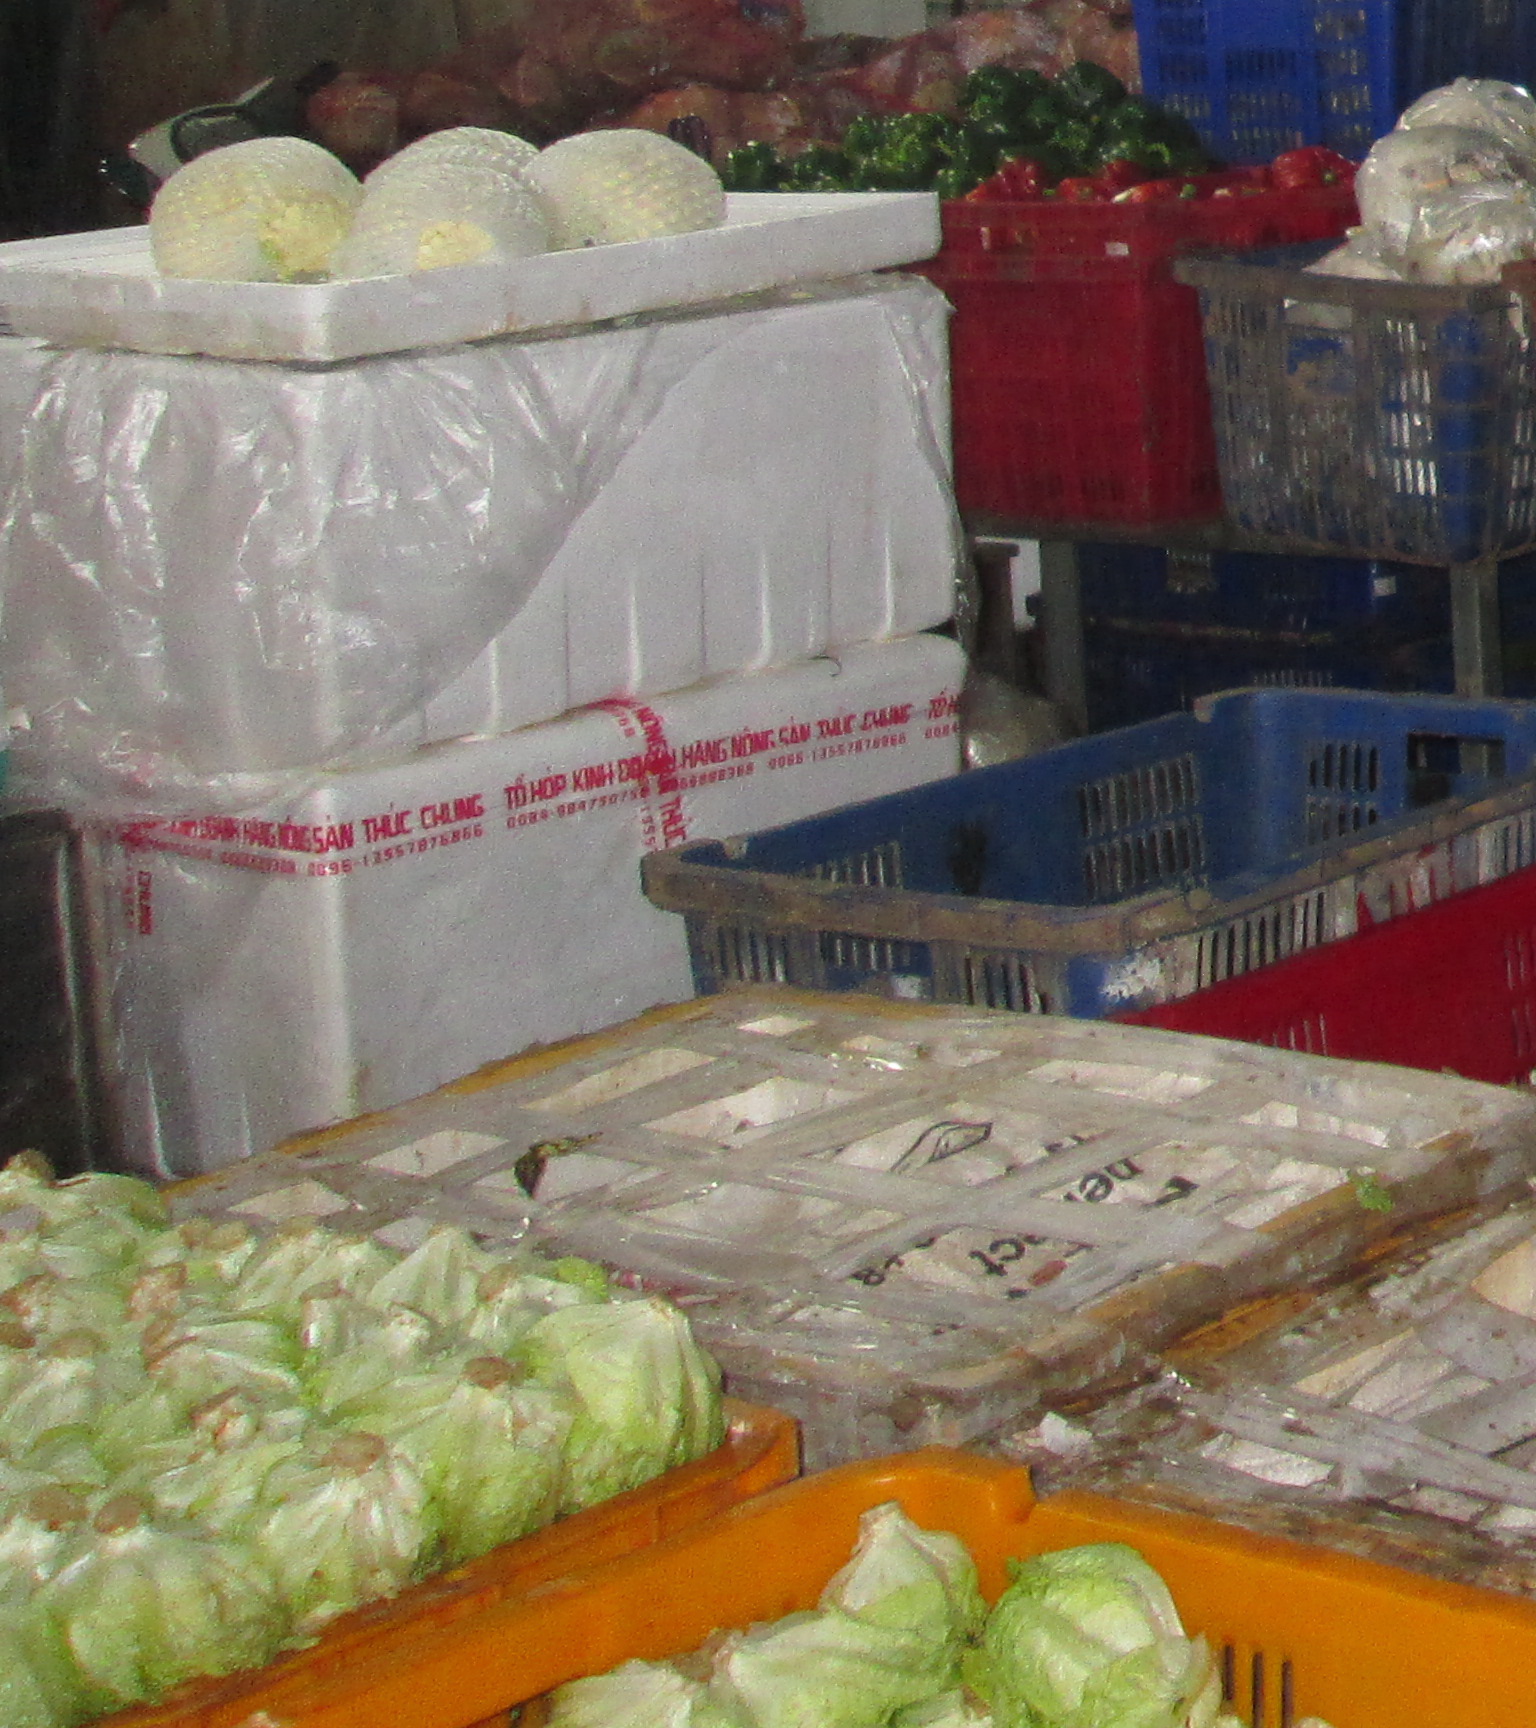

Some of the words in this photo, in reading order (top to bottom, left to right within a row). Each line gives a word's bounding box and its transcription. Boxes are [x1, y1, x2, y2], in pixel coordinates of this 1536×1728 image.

[504, 772, 529, 811] TỔ
[573, 761, 615, 794] KINH
[361, 801, 413, 844] THỨC
[420, 793, 486, 830] CHUNG
